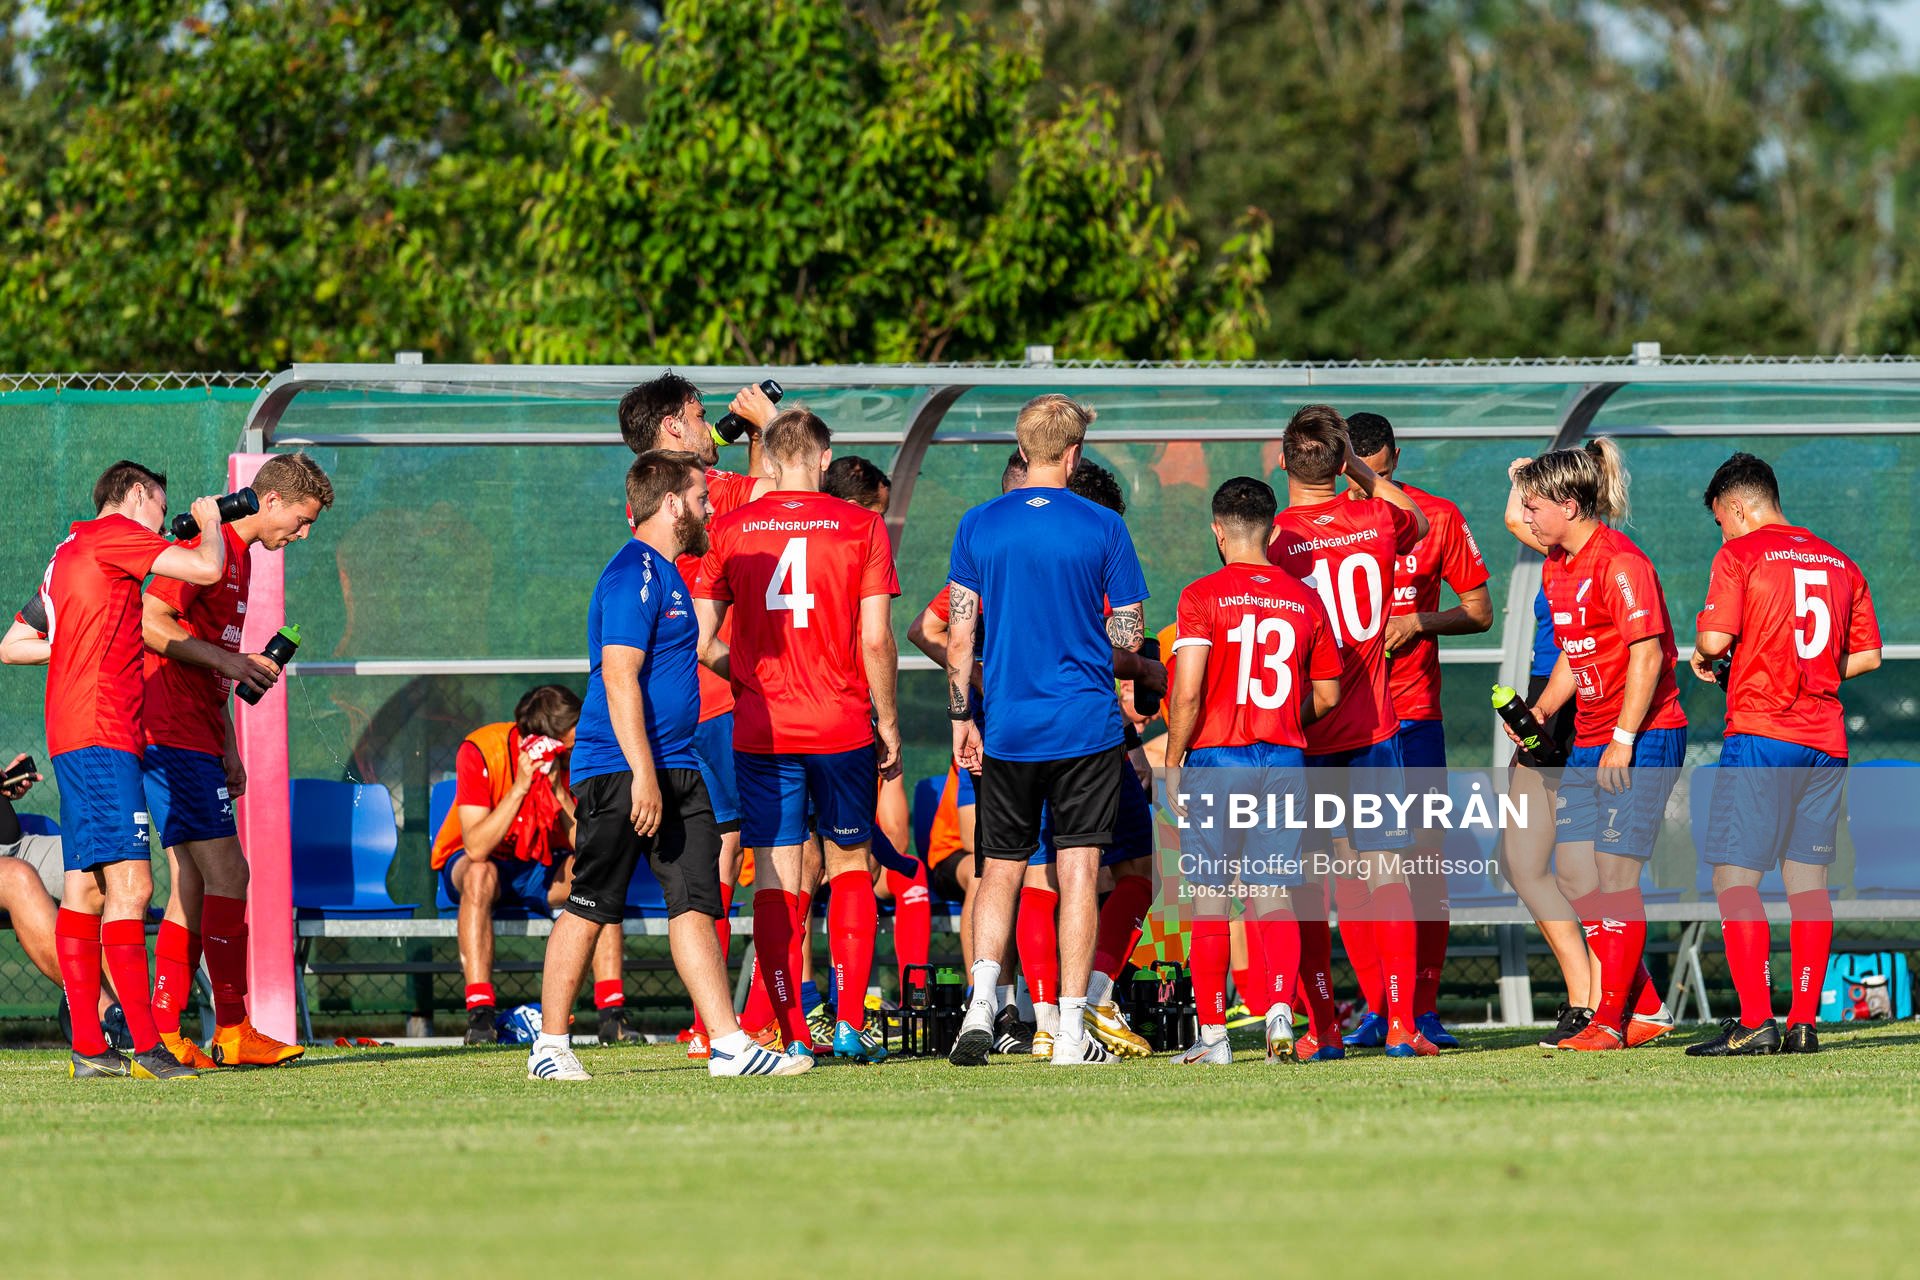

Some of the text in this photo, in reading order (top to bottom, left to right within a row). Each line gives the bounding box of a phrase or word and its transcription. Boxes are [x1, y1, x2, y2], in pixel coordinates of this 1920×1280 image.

[742, 518, 840, 533] LINDÉNGRUPPEN
[1288, 528, 1378, 555] LINDÉNGRUPPEN
[1405, 555, 1417, 574] 9
[1765, 549, 1846, 569] LINDÉNGRUPPEN
[766, 537, 815, 628] 4
[1219, 592, 1305, 614] LINDÉNGRUPPEN
[1301, 552, 1382, 648] 10
[1793, 567, 1831, 660] 5
[1578, 607, 1587, 626] 7
[1227, 613, 1296, 710] 13
[1608, 808, 1618, 828] 7
[570, 894, 597, 908] umbro
[774, 969, 788, 1002] umbro
[836, 963, 844, 991] umbro
[1315, 972, 1330, 1000] umbro
[1389, 974, 1398, 1003] umbro
[1800, 966, 1811, 992] umbro
